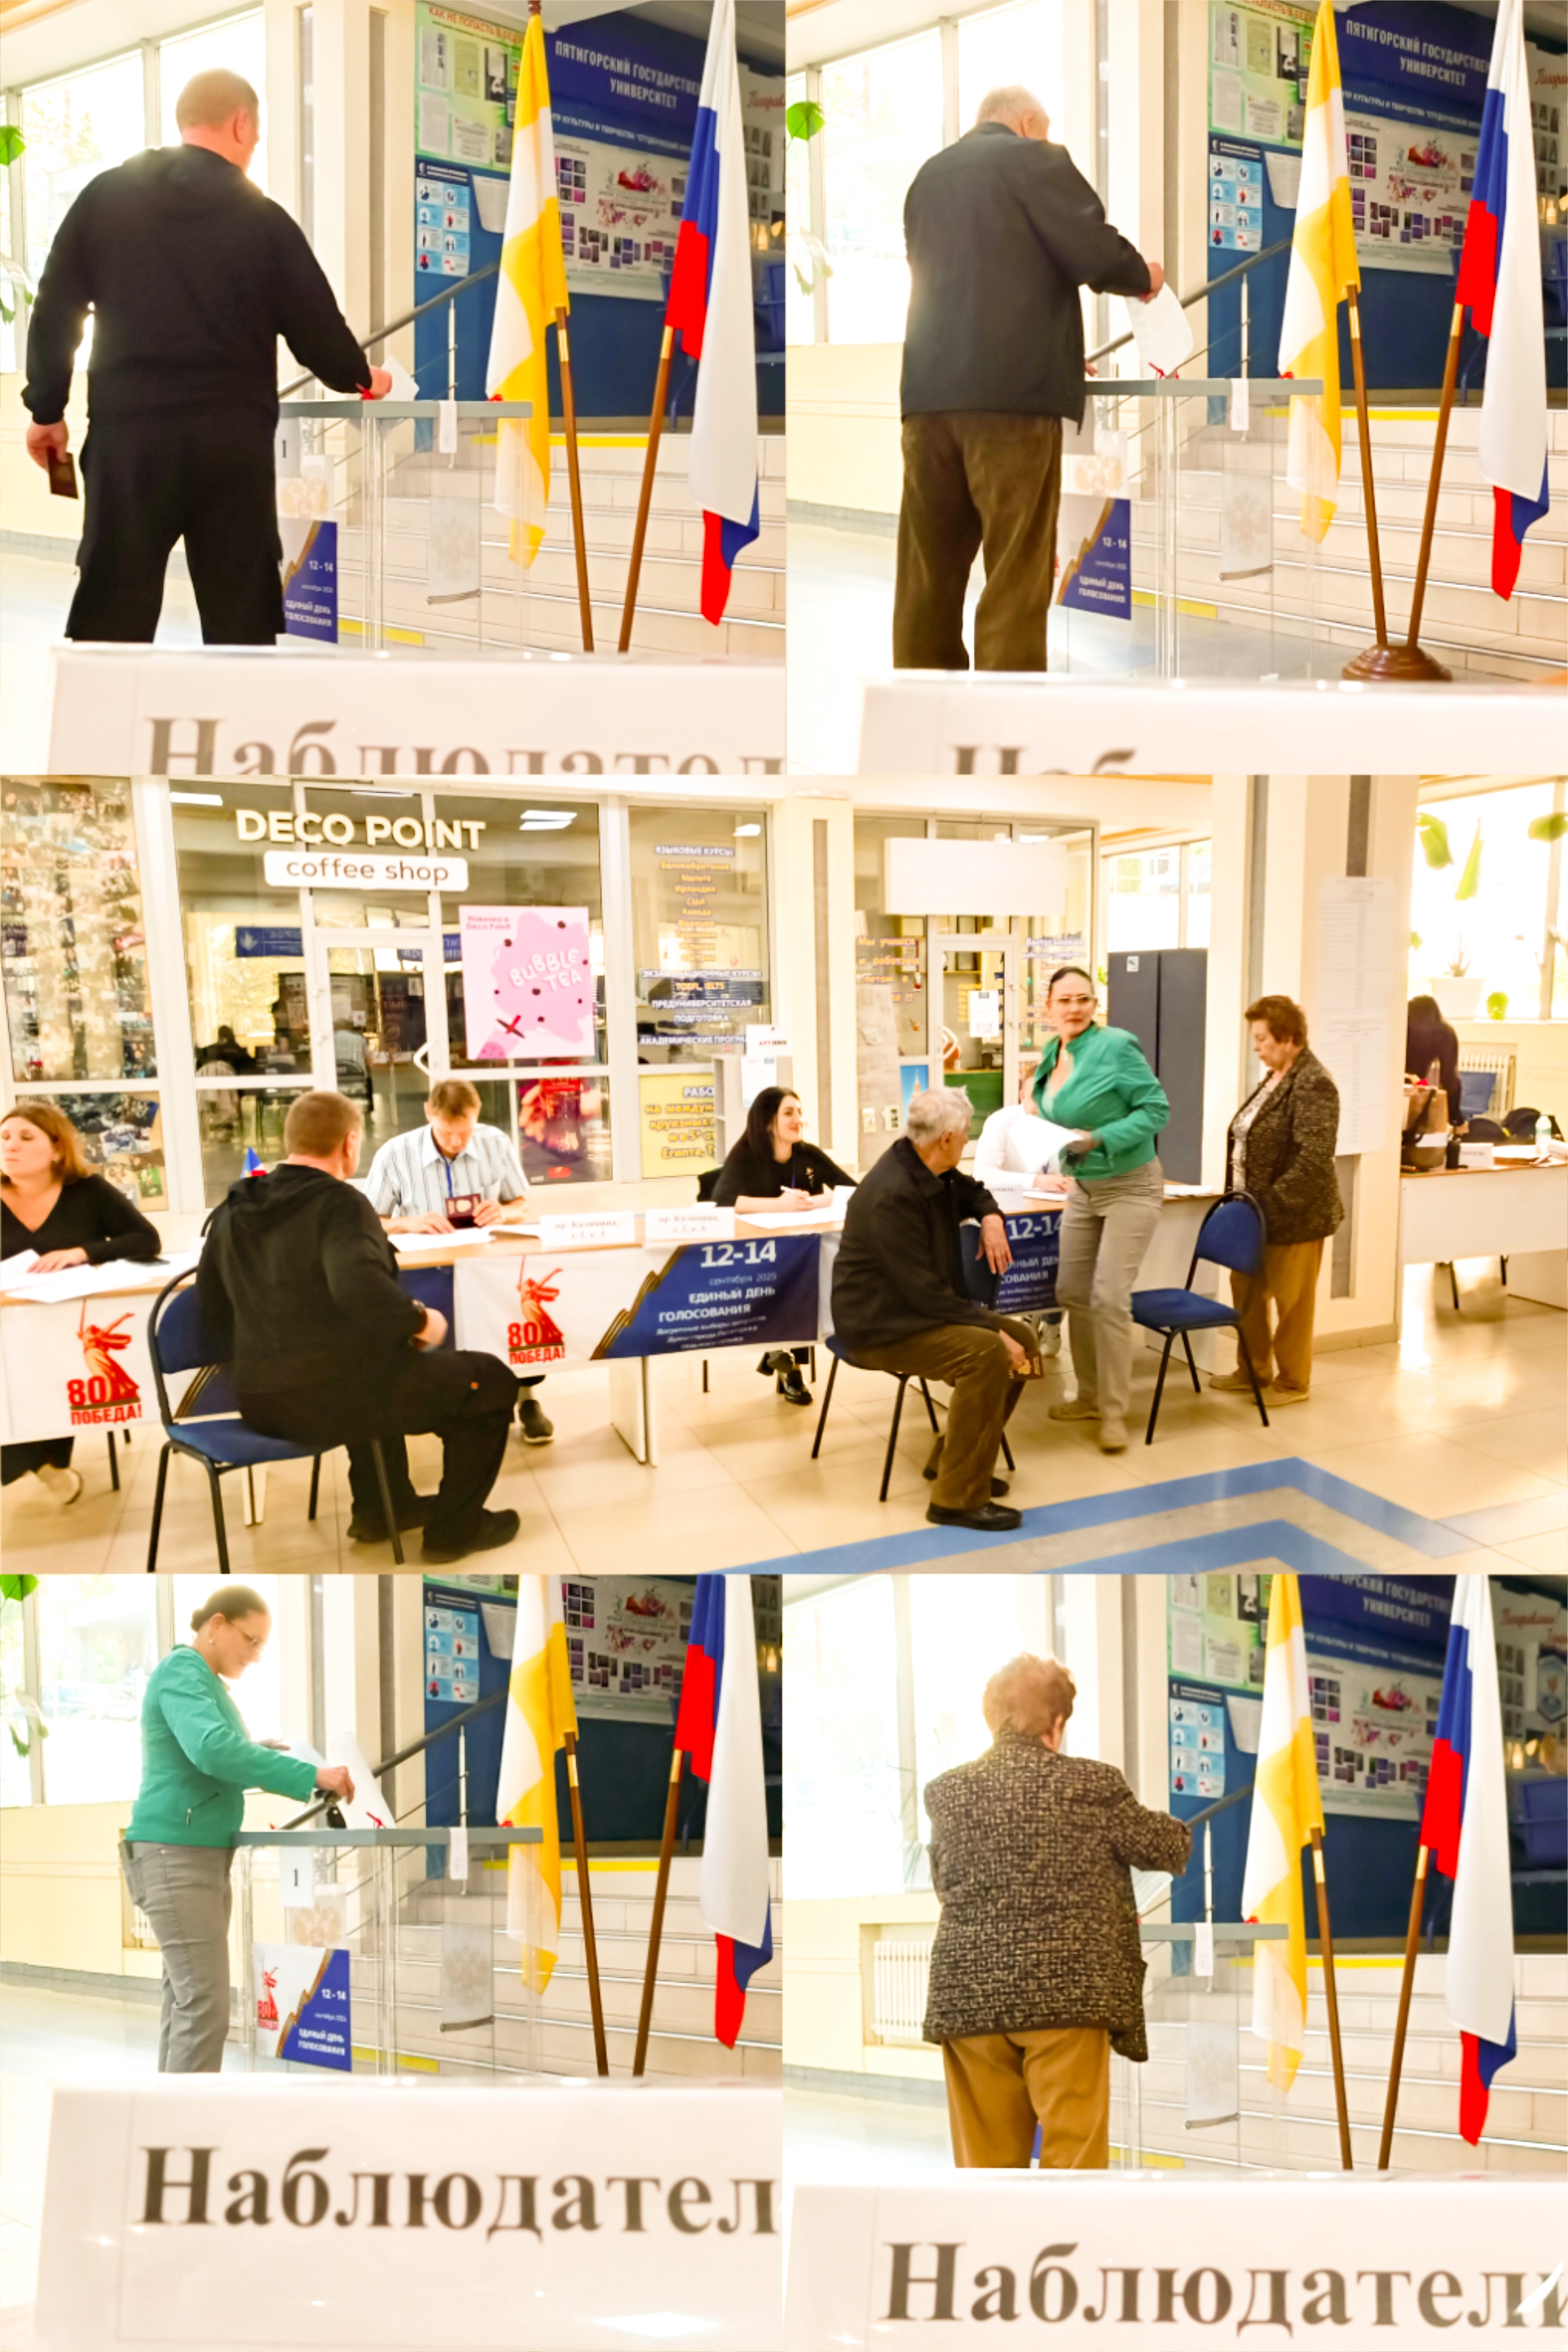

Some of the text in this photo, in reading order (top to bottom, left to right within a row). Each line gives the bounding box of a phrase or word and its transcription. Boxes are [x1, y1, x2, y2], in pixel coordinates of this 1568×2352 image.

[447, 13, 457, 23] НЕ
[1346, 19, 1420, 54] ПЯТИГОРСКИЙ
[555, 40, 630, 76] ПЯТИГОРСКИЙ
[1399, 56, 1466, 87] УНИВЕРСИТЕТ
[610, 78, 678, 109] УНИВЕРСИТЕТ
[236, 810, 487, 850] DECO POINT
[286, 858, 449, 886] coffee shop
[509, 949, 579, 987] BUBBLE
[542, 969, 583, 991] TEA
[701, 1240, 776, 1268] 12-14
[709, 1274, 752, 1286] сентября
[688, 1286, 775, 1304] ЕДИНЫЙ ДЕНЬ
[658, 1303, 751, 1323] ГОЛОСОВАНИЯ
[507, 1322, 538, 1348] 80
[508, 1346, 566, 1366] ПОБЕДА!
[66, 1376, 106, 1406] 80
[71, 1404, 142, 1426] ПОБЕДА!
[1363, 1596, 1431, 1628] УНИВЕРСИТЕТ
[293, 1868, 298, 1887] 1
[139, 2146, 779, 2244] Наблюдател
